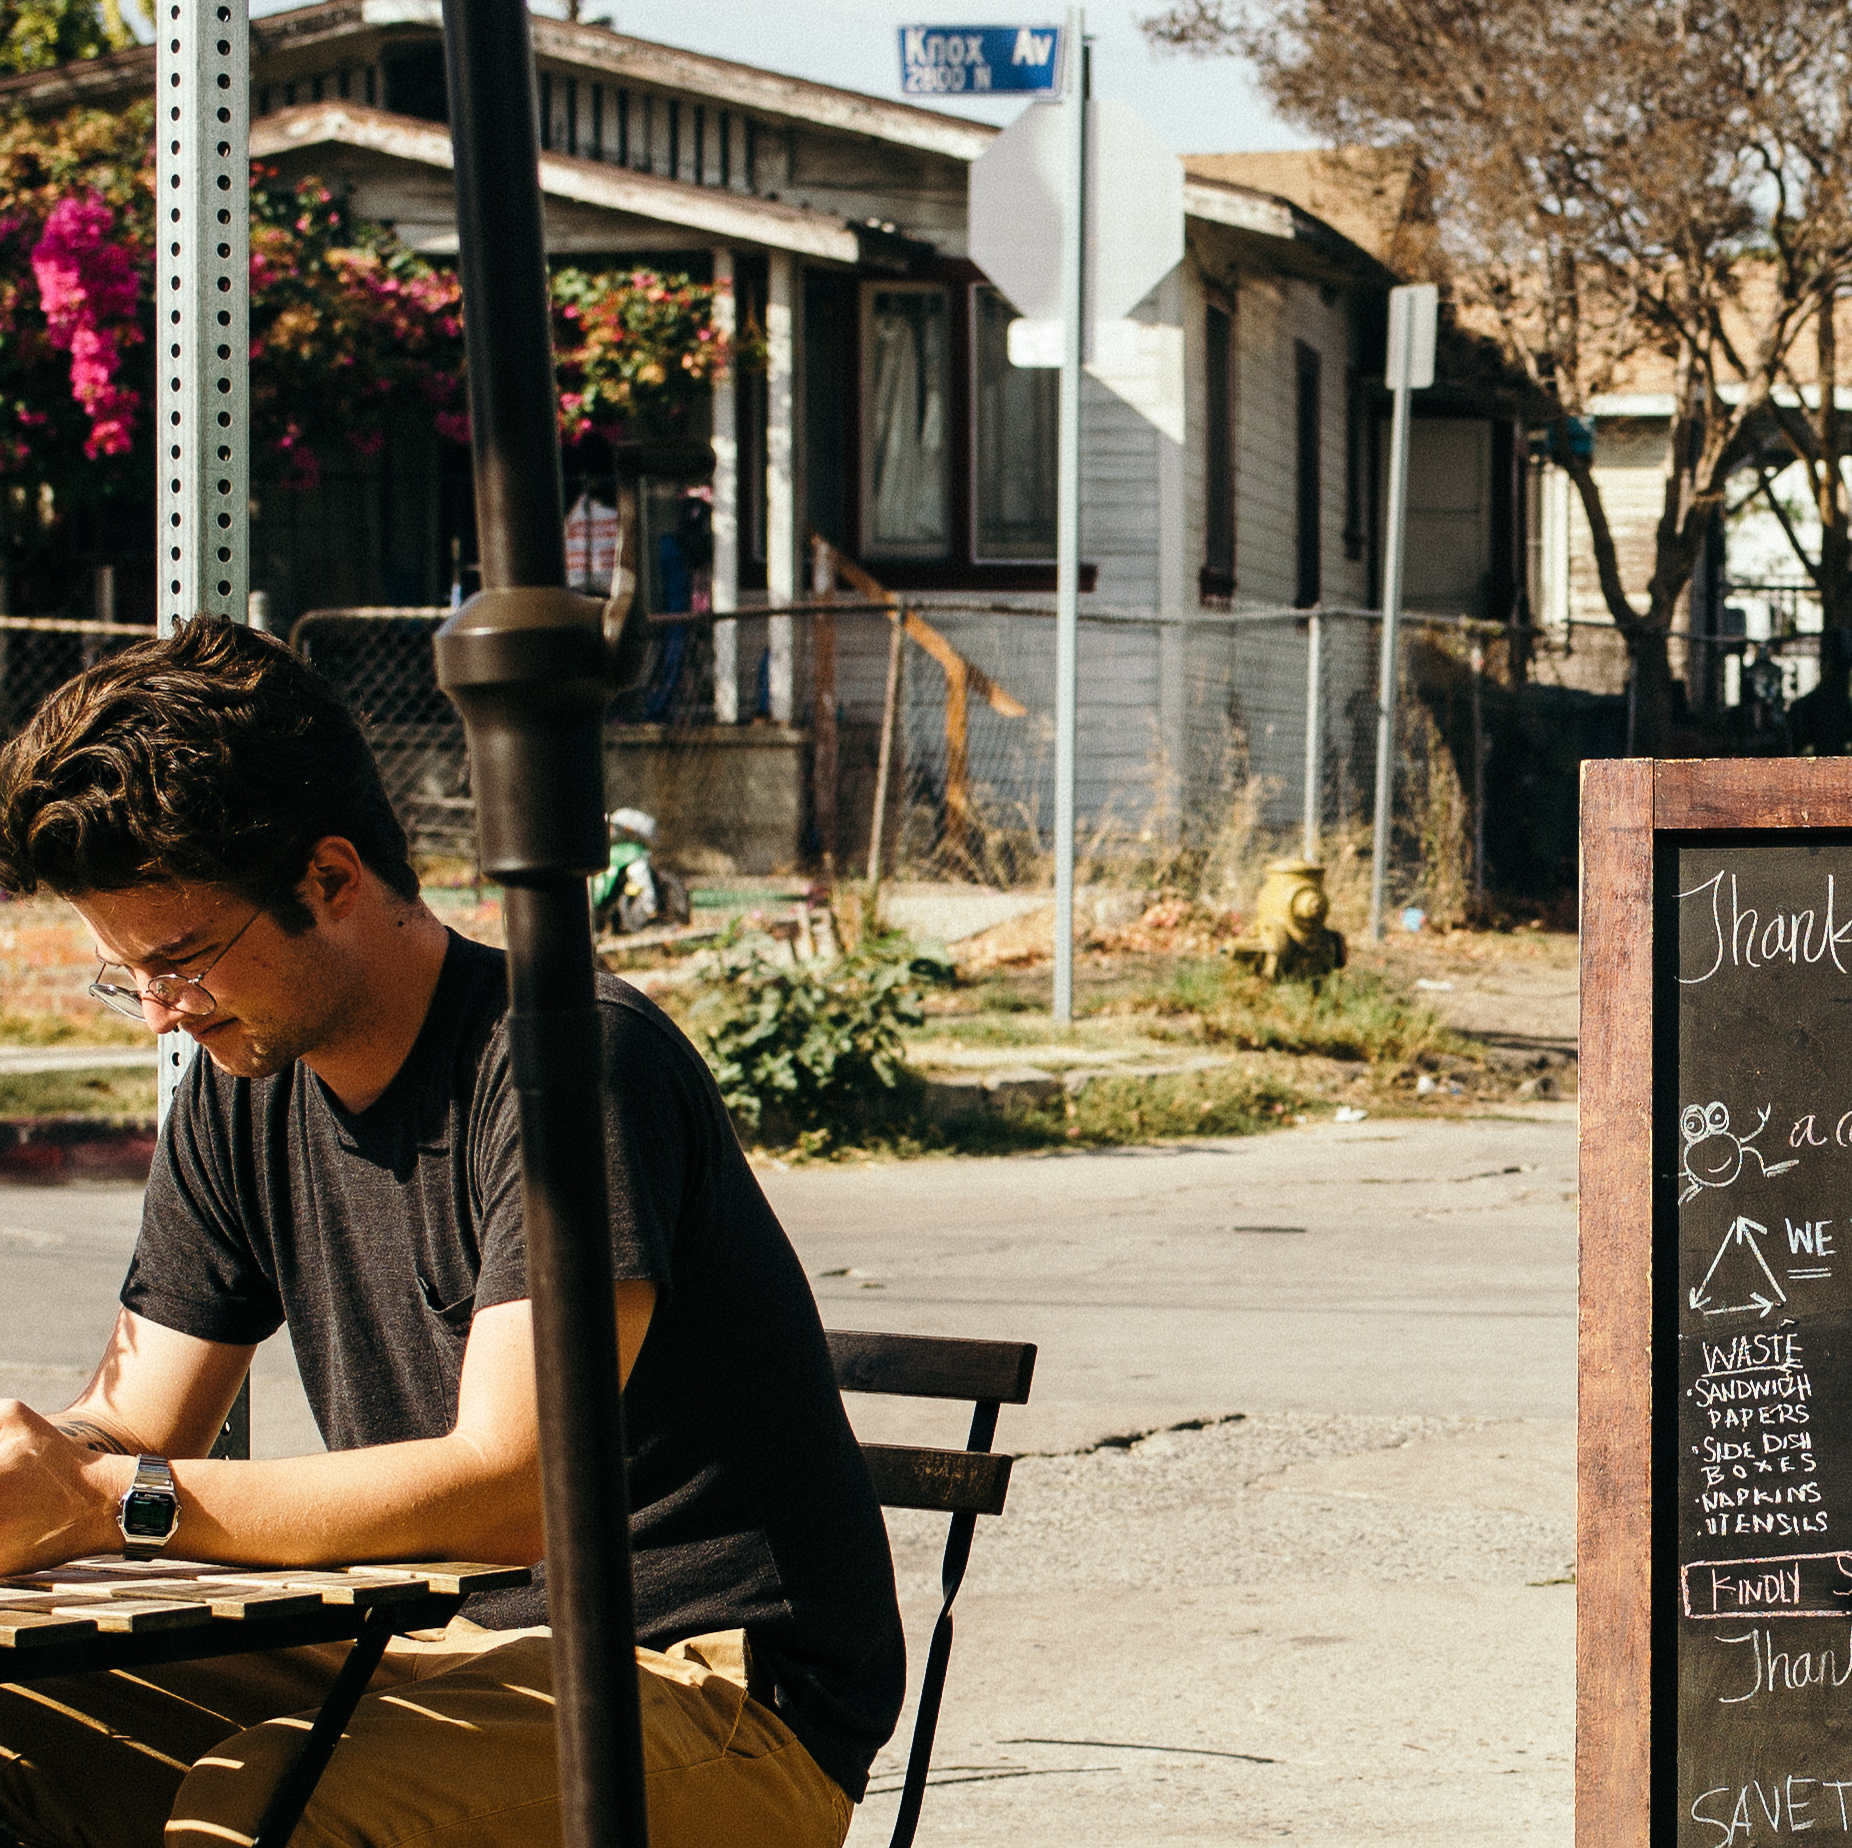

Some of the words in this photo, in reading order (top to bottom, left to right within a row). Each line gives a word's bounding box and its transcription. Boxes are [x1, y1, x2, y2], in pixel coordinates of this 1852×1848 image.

[904, 27, 986, 67] Knox
[1011, 26, 1053, 67] Av
[973, 65, 992, 91] N
[1789, 1114, 1828, 1148] a
[1784, 1216, 1836, 1258] WE
[1702, 1333, 1804, 1374] WASTE
[1694, 1373, 1812, 1408] SANDWICH
[1707, 1403, 1811, 1430] PAPERS
[1702, 1435, 1756, 1464] SIDE
[1762, 1431, 1812, 1454] DISH
[1700, 1452, 1817, 1487] BOXES
[1701, 1481, 1823, 1513] NAPKINS
[1704, 1510, 1829, 1537] UTENSILS
[1711, 1561, 1801, 1612] KINDLY
